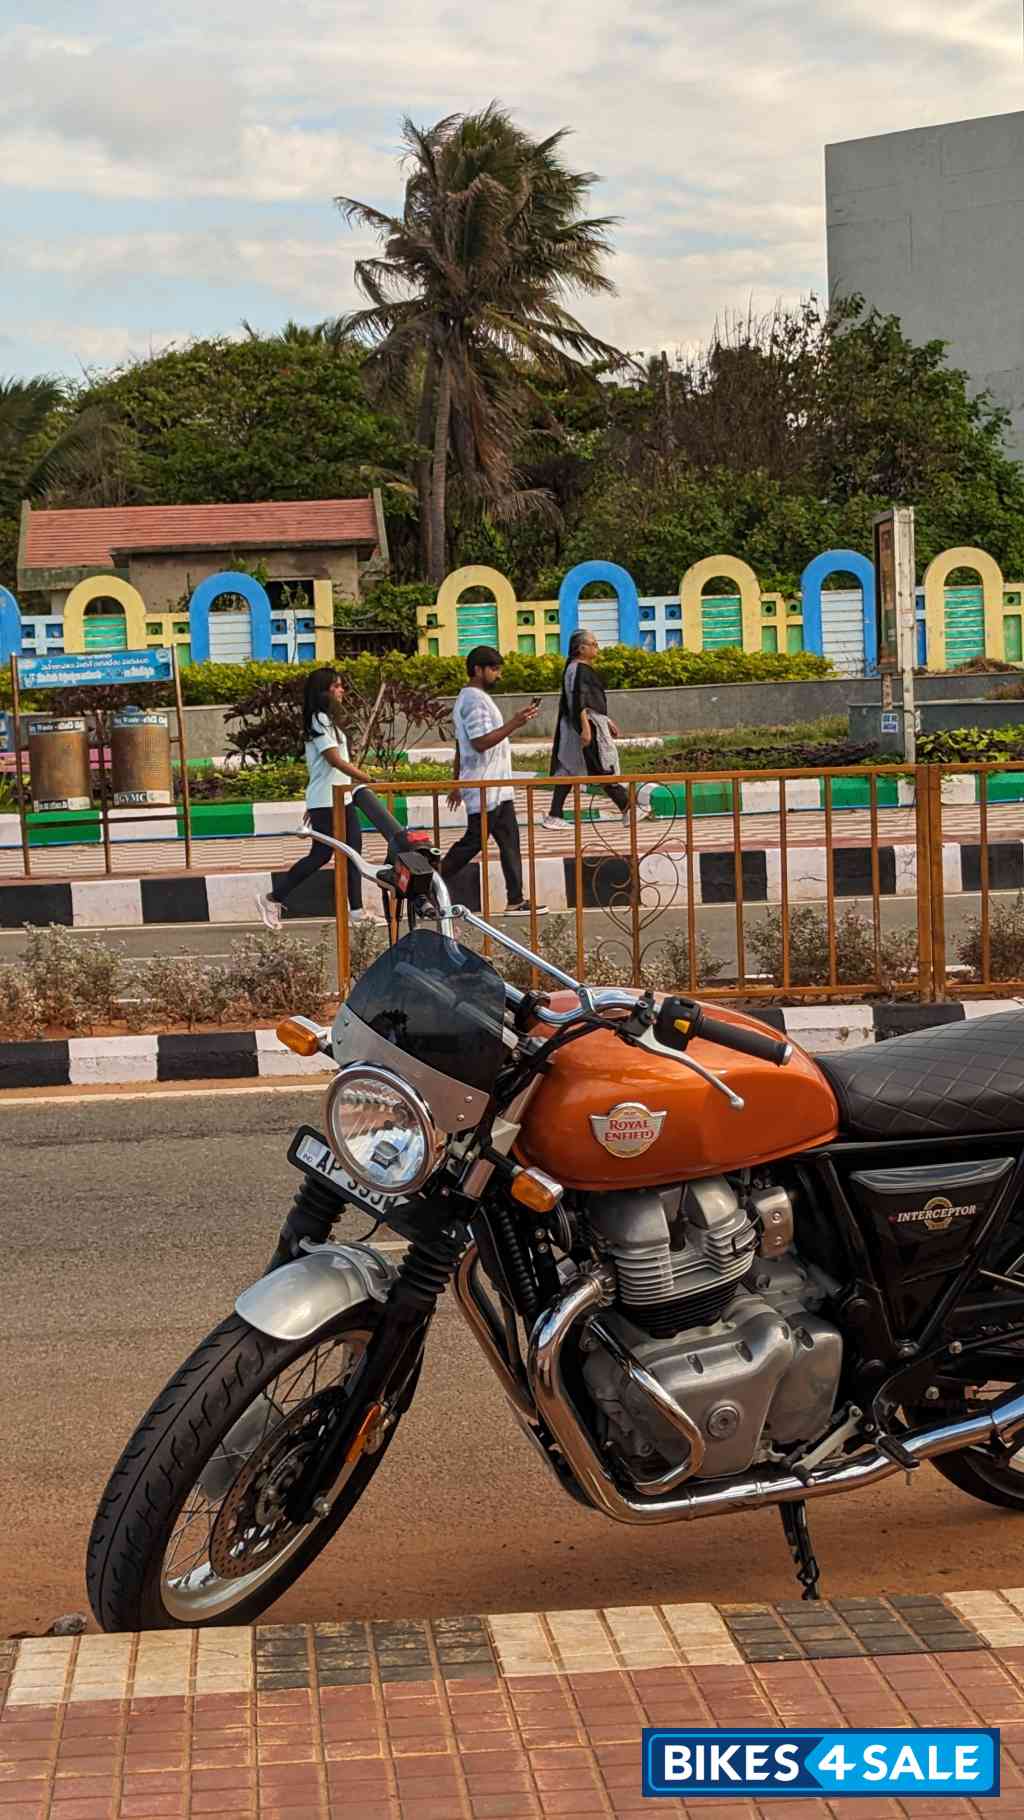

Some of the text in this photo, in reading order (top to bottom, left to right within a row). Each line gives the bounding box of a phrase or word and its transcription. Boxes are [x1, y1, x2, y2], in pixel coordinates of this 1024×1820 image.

[609, 1119, 651, 1131] ROYAL
[604, 1130, 654, 1142] ENFIELD
[896, 1204, 977, 1223] INTERCEPTOR
